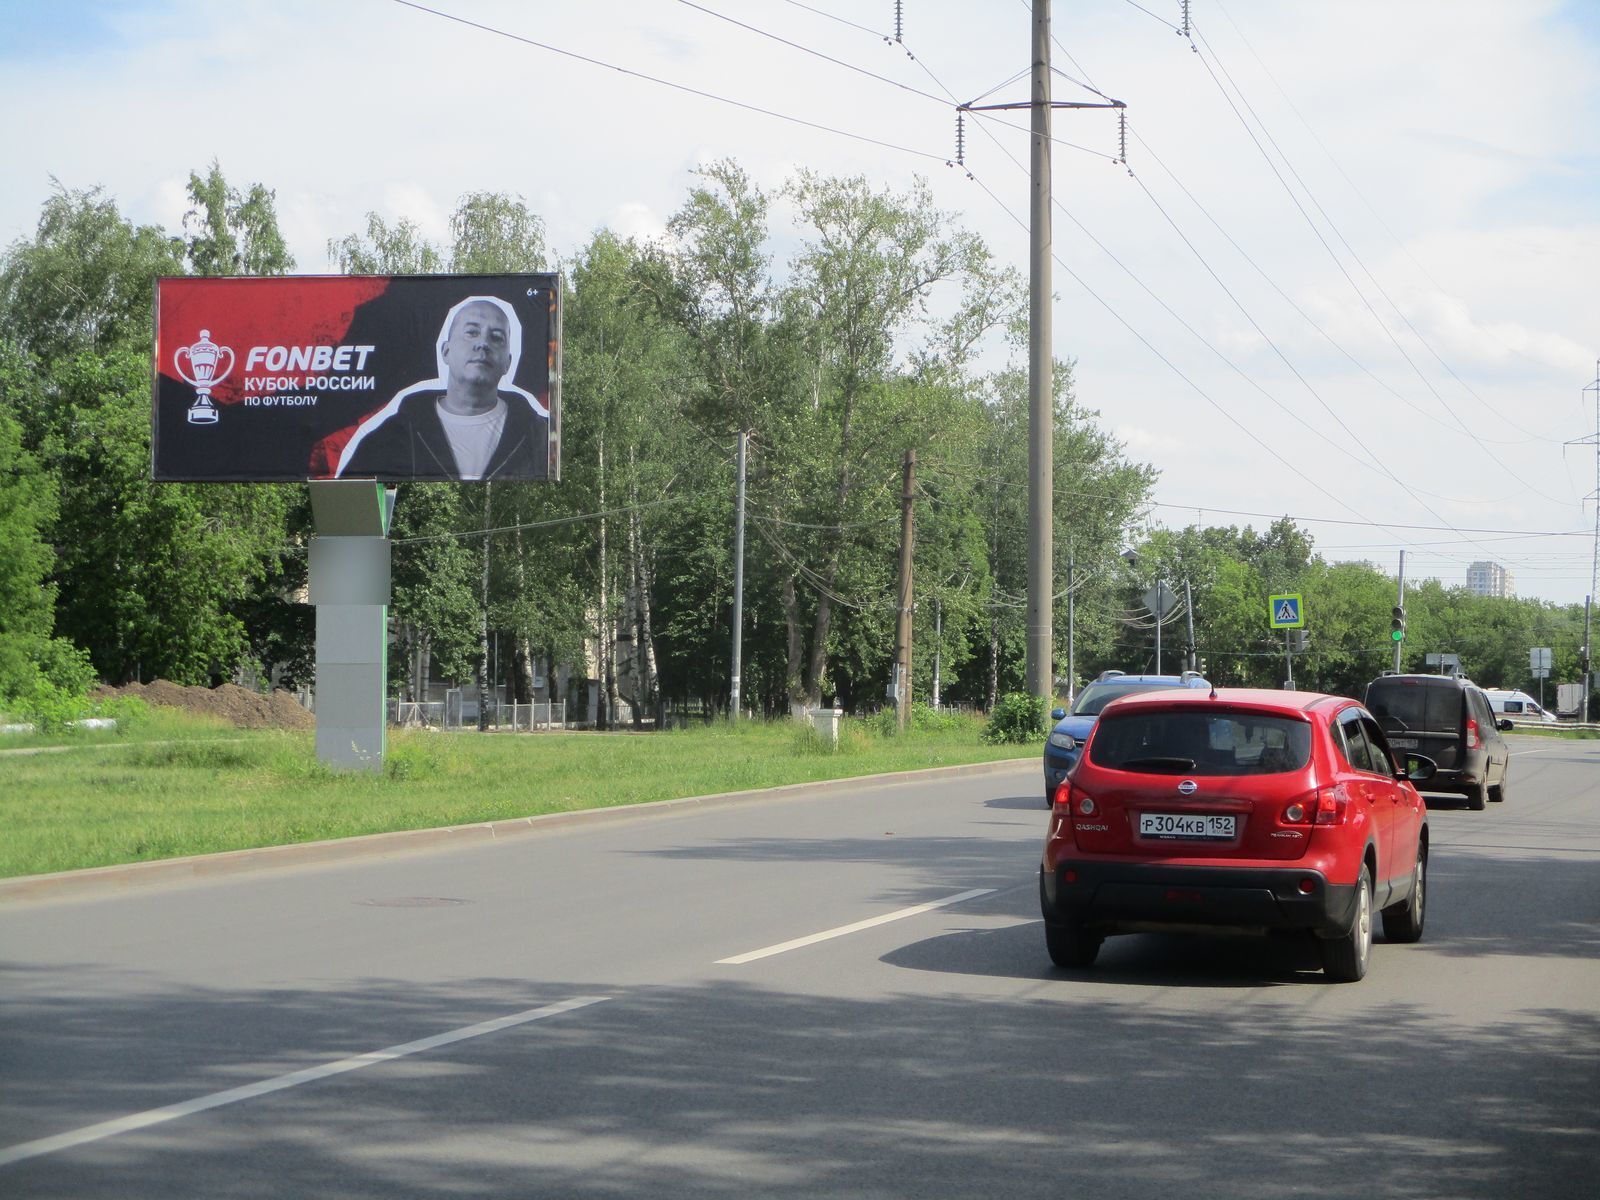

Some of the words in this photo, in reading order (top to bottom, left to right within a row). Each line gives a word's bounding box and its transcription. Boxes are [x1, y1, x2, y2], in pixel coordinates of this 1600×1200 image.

[526, 288, 539, 297] 6+
[245, 345, 376, 372] FONBET
[244, 377, 300, 391] КУБОК
[305, 376, 375, 390] РОССИИ
[244, 396, 261, 406] ПО
[262, 395, 318, 407] ФУТБОЛУ
[1075, 823, 1109, 831] QASHQAI
[1208, 817, 1231, 830] 152
